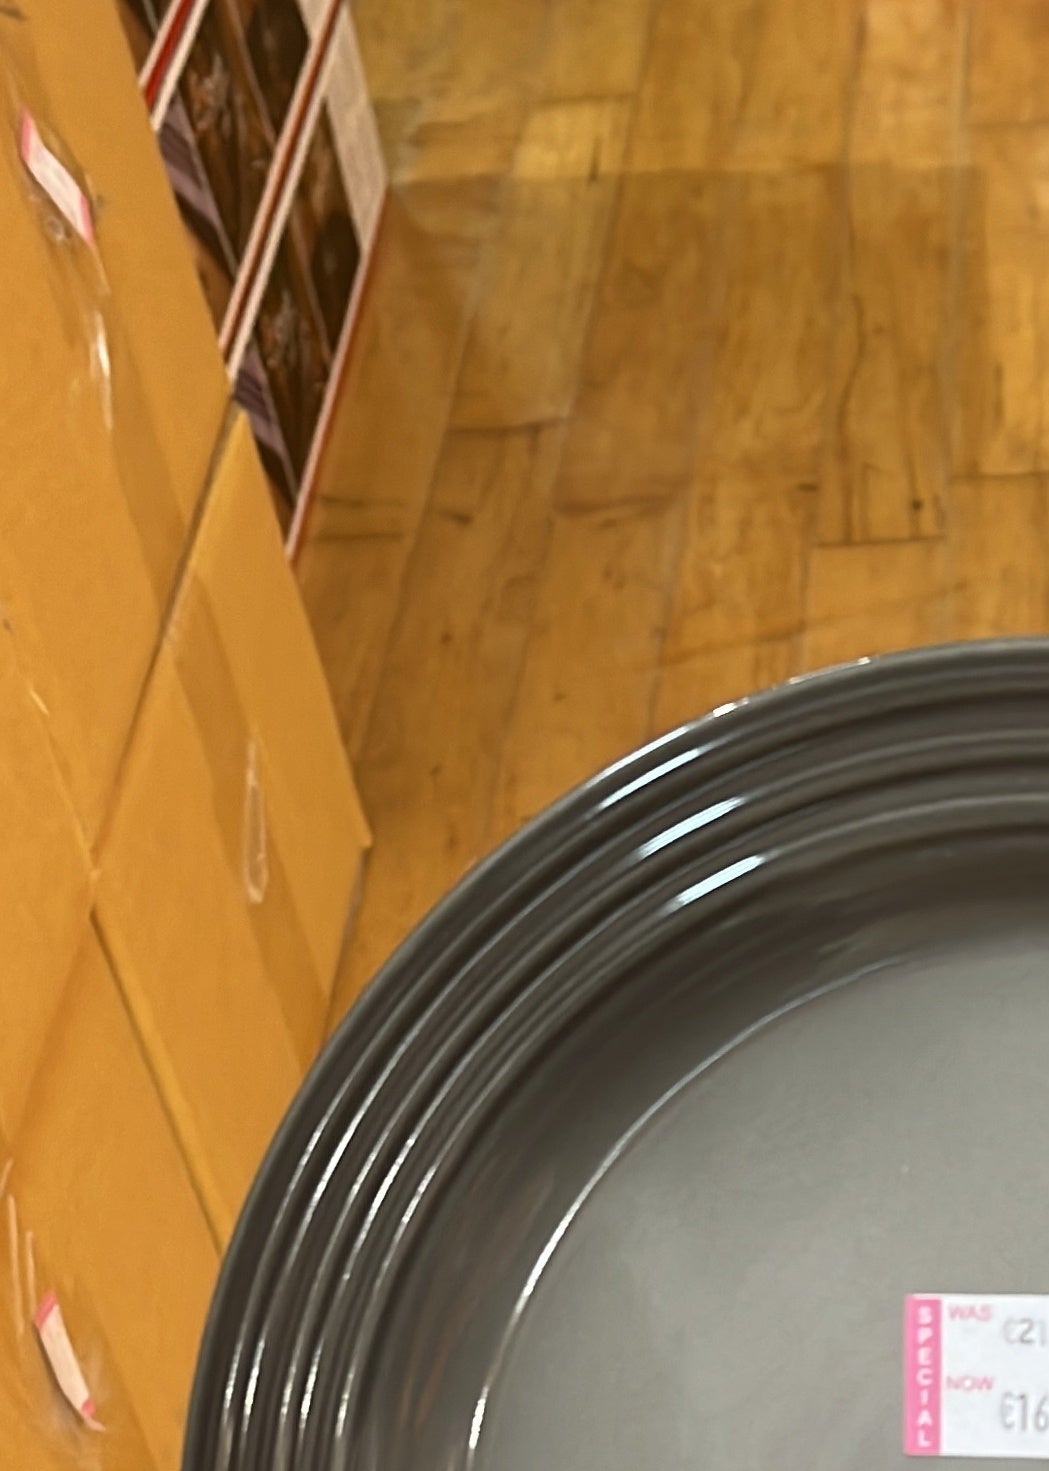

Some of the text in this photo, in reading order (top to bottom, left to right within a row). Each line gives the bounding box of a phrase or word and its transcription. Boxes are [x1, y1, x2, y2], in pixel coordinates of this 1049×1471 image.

[948, 1305, 992, 1321] WAS
[916, 1306, 932, 1447] SPECIAL
[947, 1376, 993, 1391] NOW
